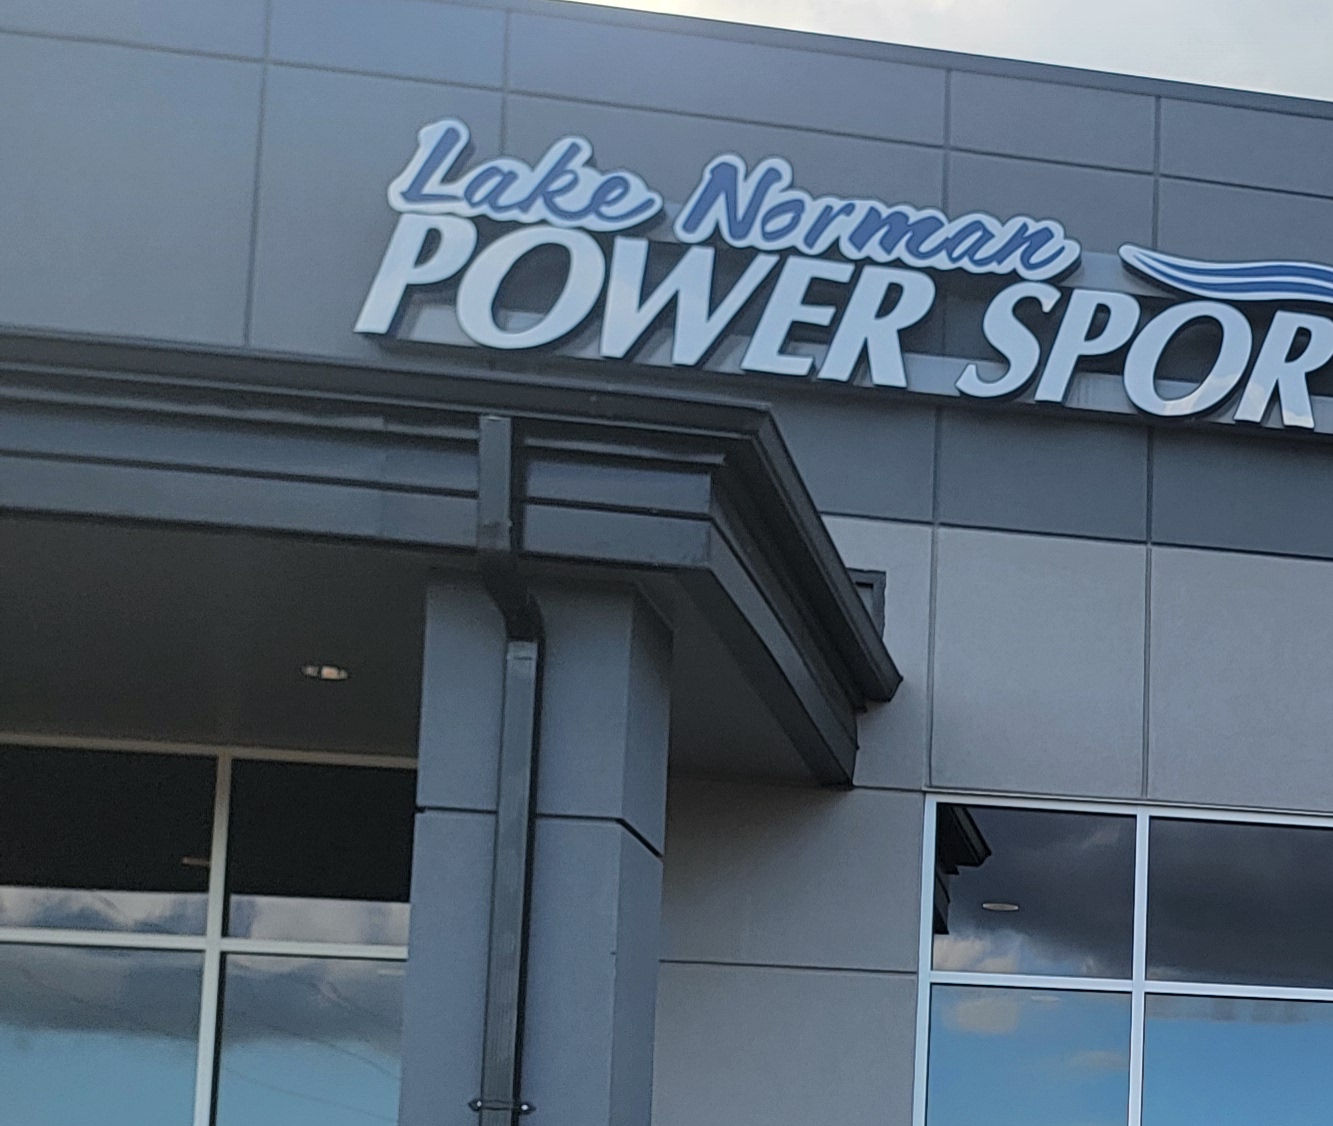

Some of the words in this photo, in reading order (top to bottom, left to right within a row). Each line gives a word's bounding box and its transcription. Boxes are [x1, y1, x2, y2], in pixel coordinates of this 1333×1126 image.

[389, 117, 663, 232] Lake
[673, 153, 1081, 281] Norman
[353, 212, 936, 388] POWER
